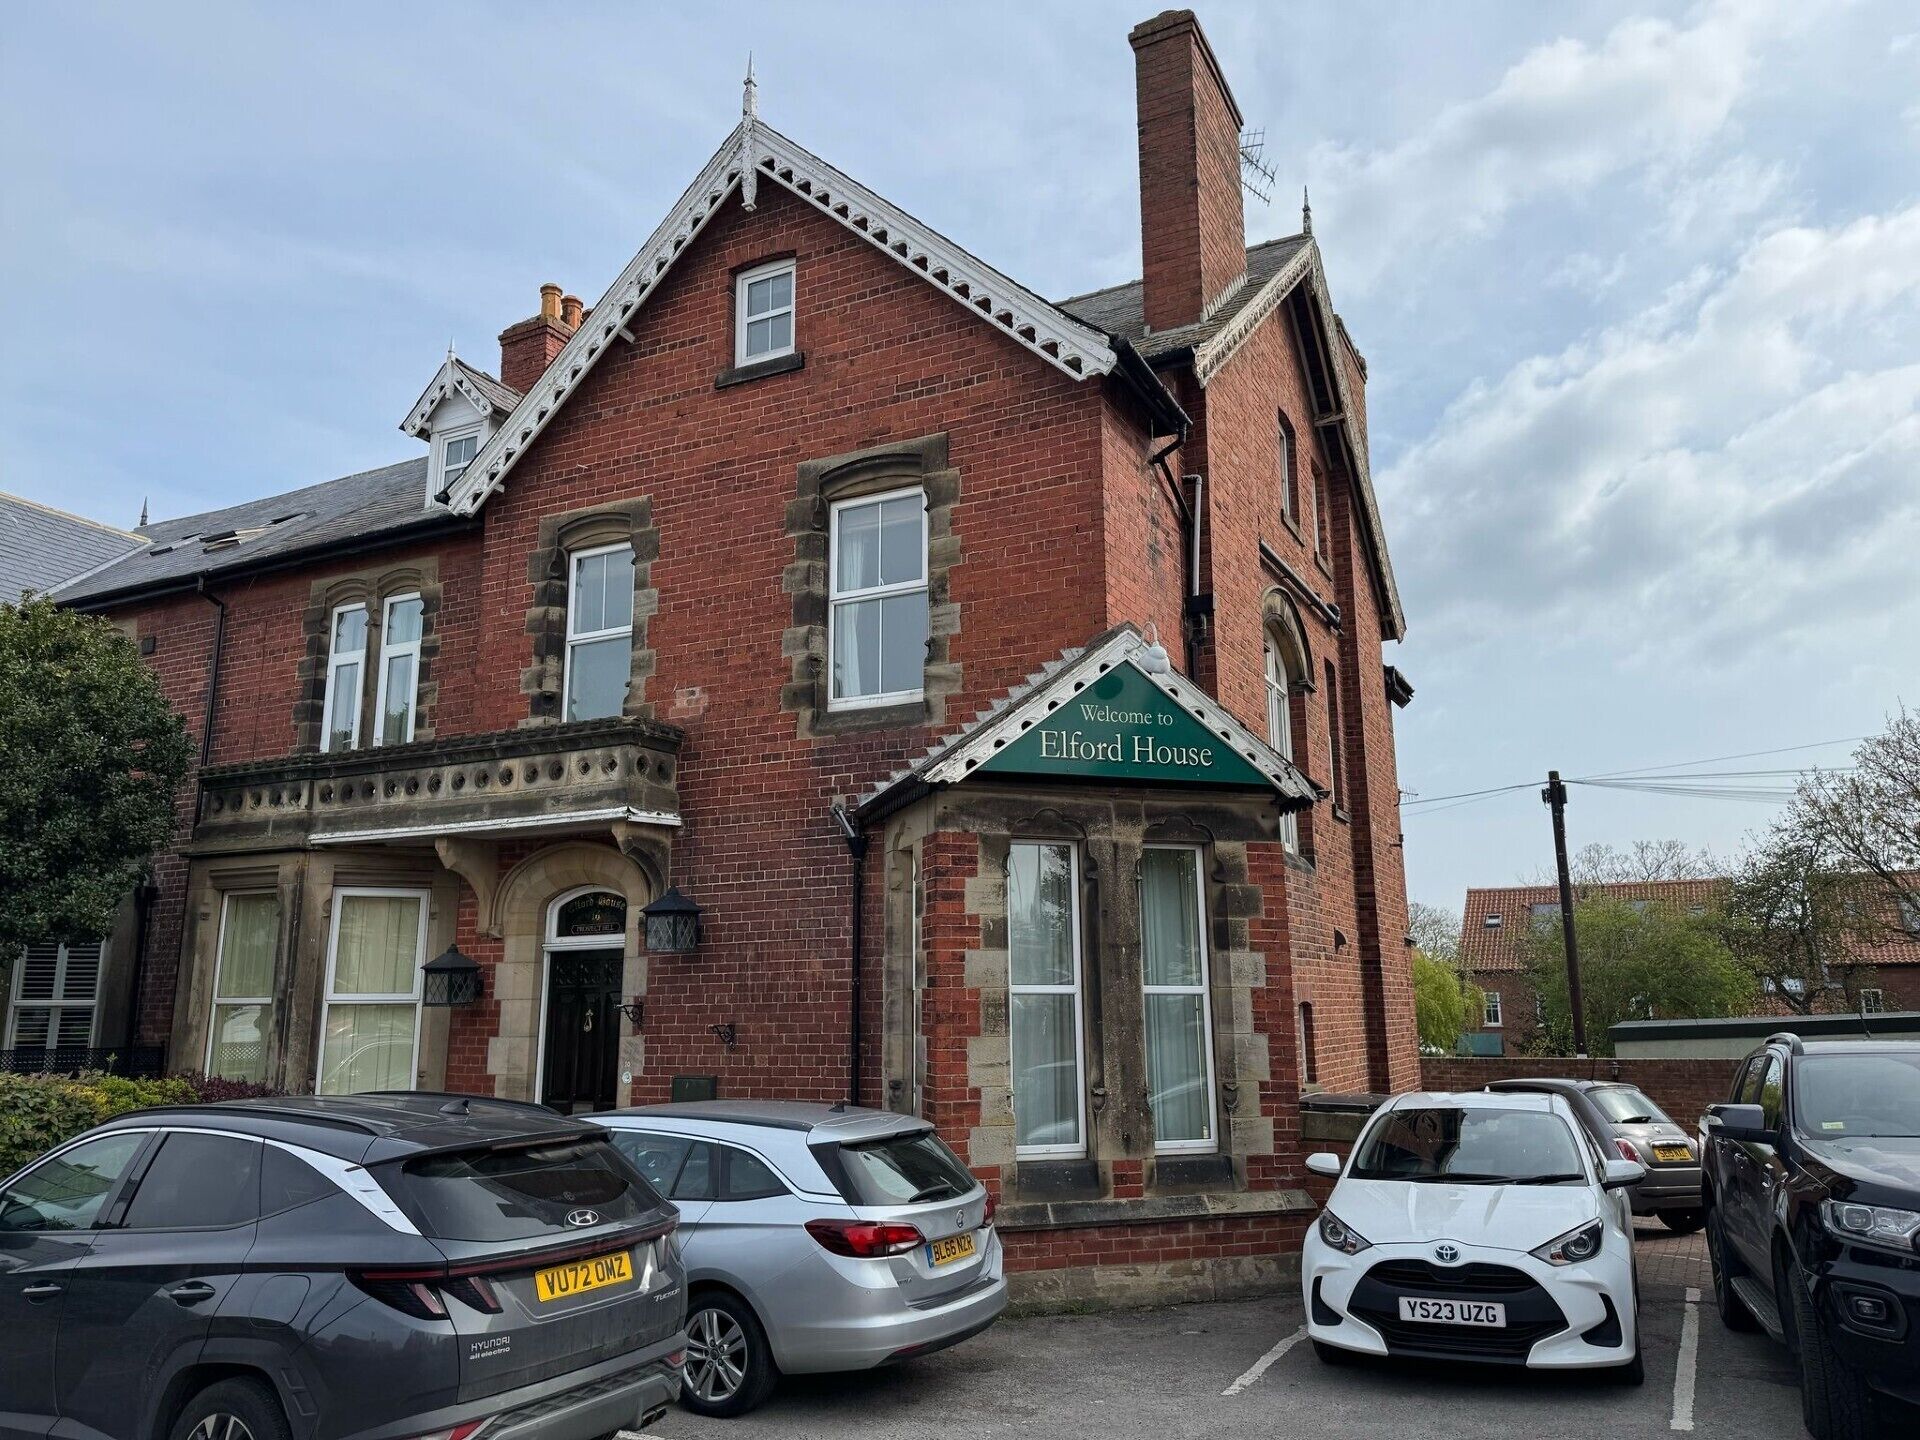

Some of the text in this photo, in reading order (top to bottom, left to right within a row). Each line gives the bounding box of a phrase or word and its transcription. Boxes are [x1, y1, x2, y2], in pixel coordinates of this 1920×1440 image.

[1080, 703, 1173, 726] Welcome to
[1038, 729, 1213, 767] Elford House
[933, 1234, 974, 1262] BL66 NZR
[545, 1256, 627, 1296] VU72 OMZ
[1407, 1300, 1497, 1323] YS23 UZG
[470, 1335, 511, 1352] HYUNDAI
